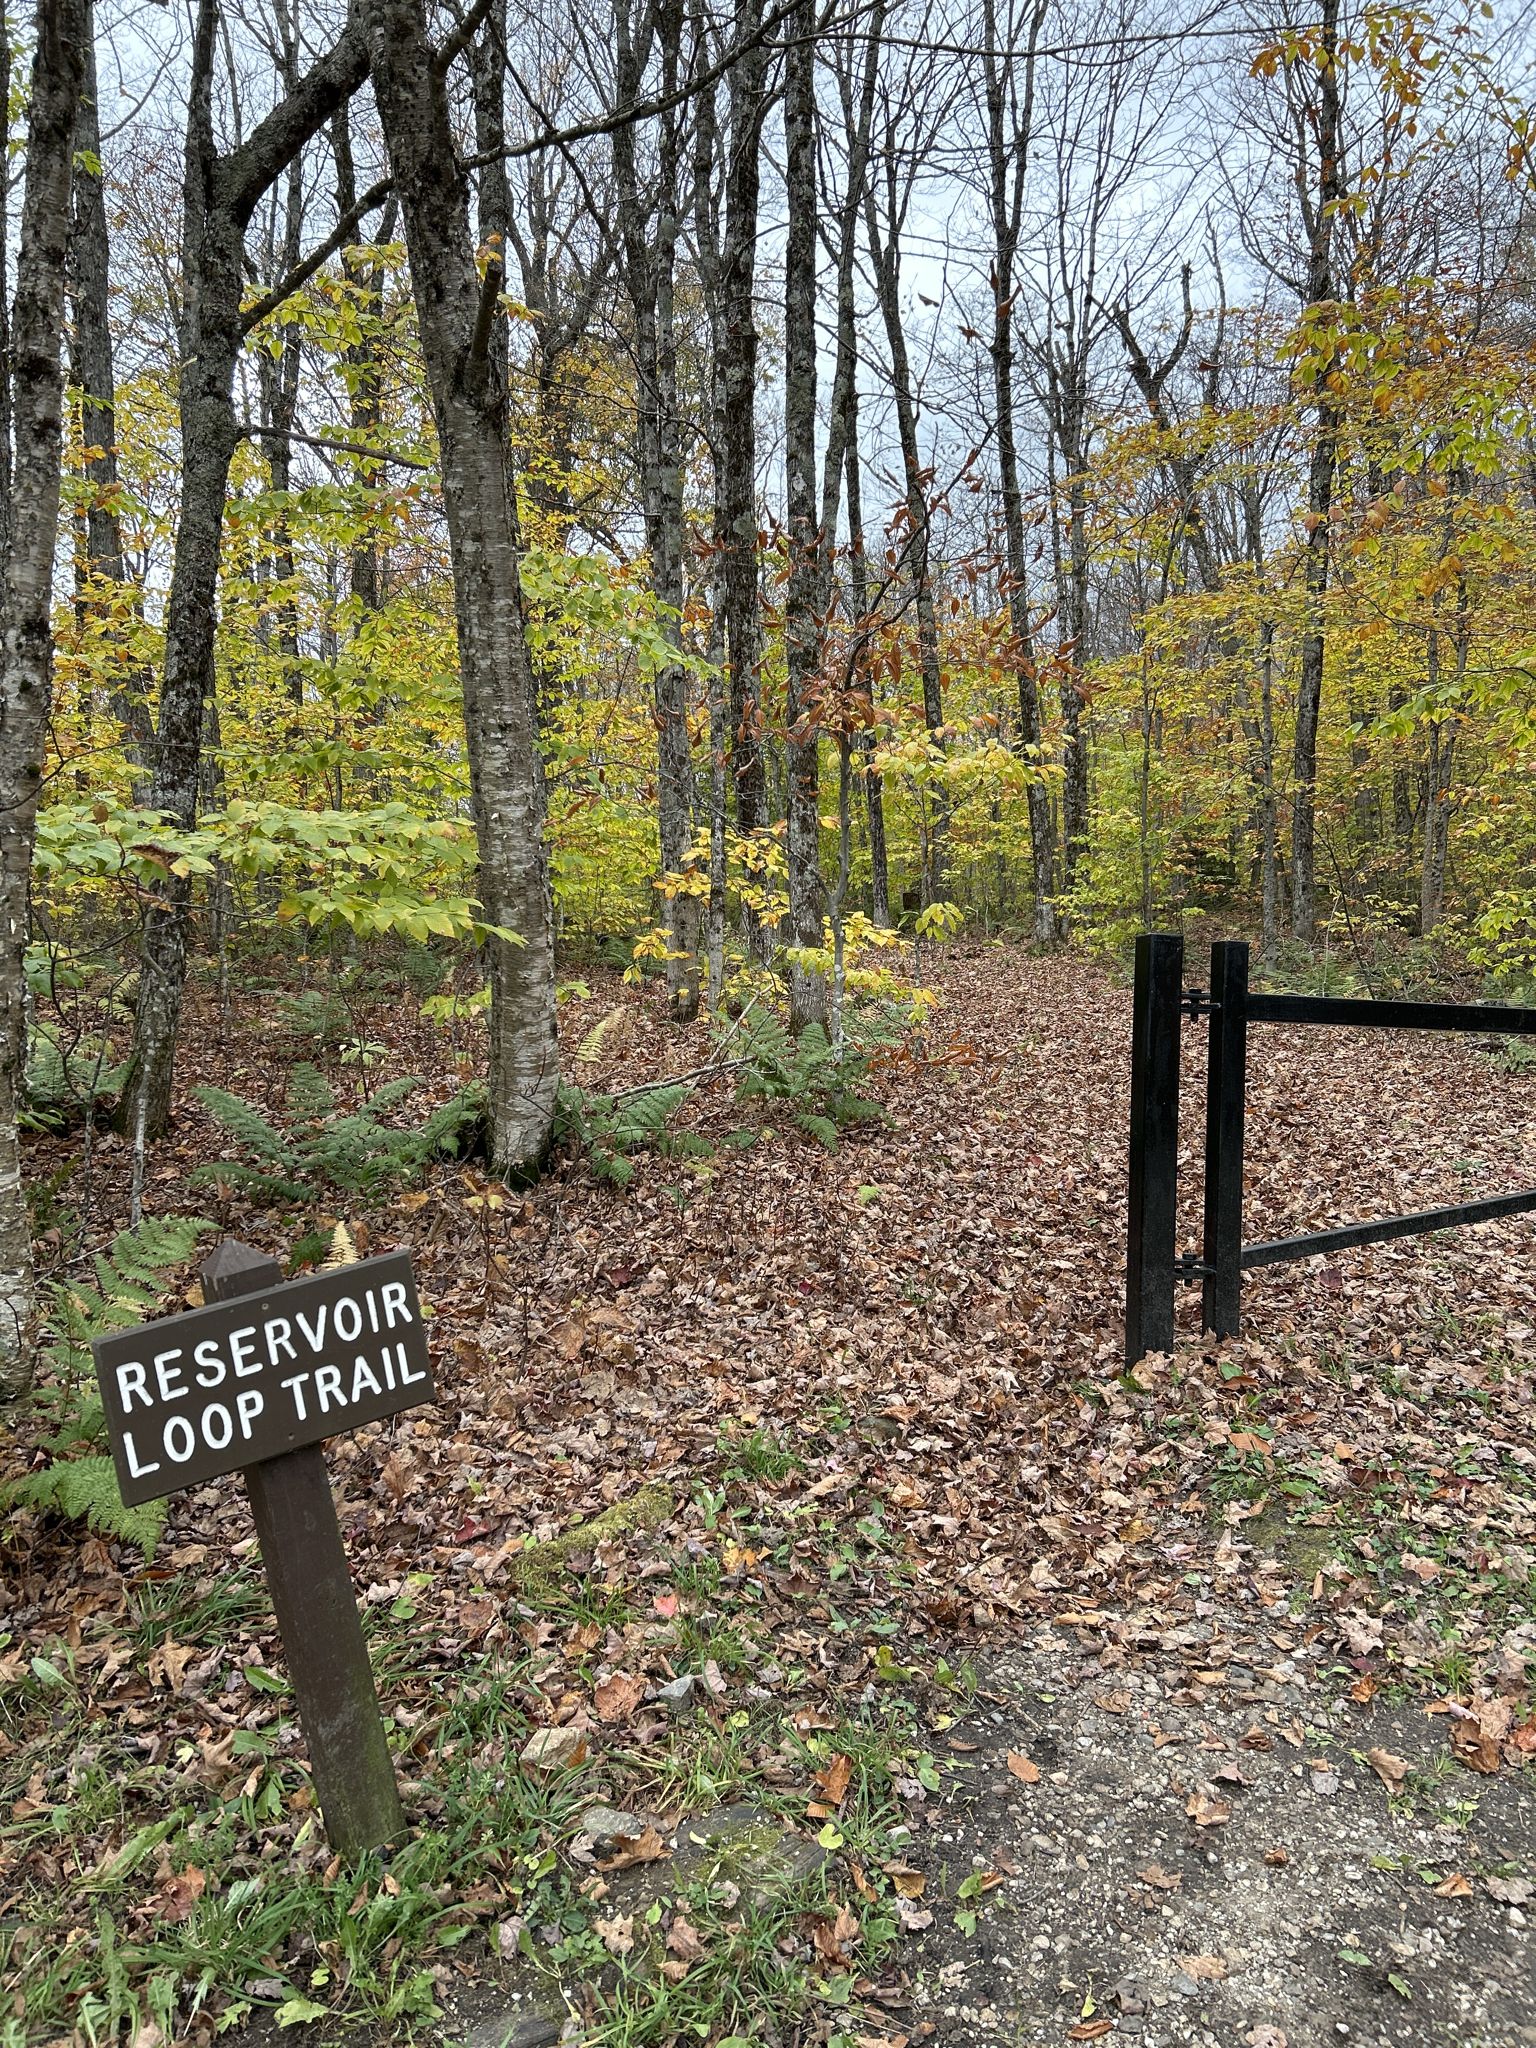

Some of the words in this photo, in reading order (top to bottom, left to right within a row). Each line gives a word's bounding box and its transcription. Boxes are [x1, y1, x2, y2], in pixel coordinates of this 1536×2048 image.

[115, 1281, 413, 1414] RESERVOIR
[122, 1390, 264, 1479] LOOP
[280, 1342, 427, 1421] TRAIL
